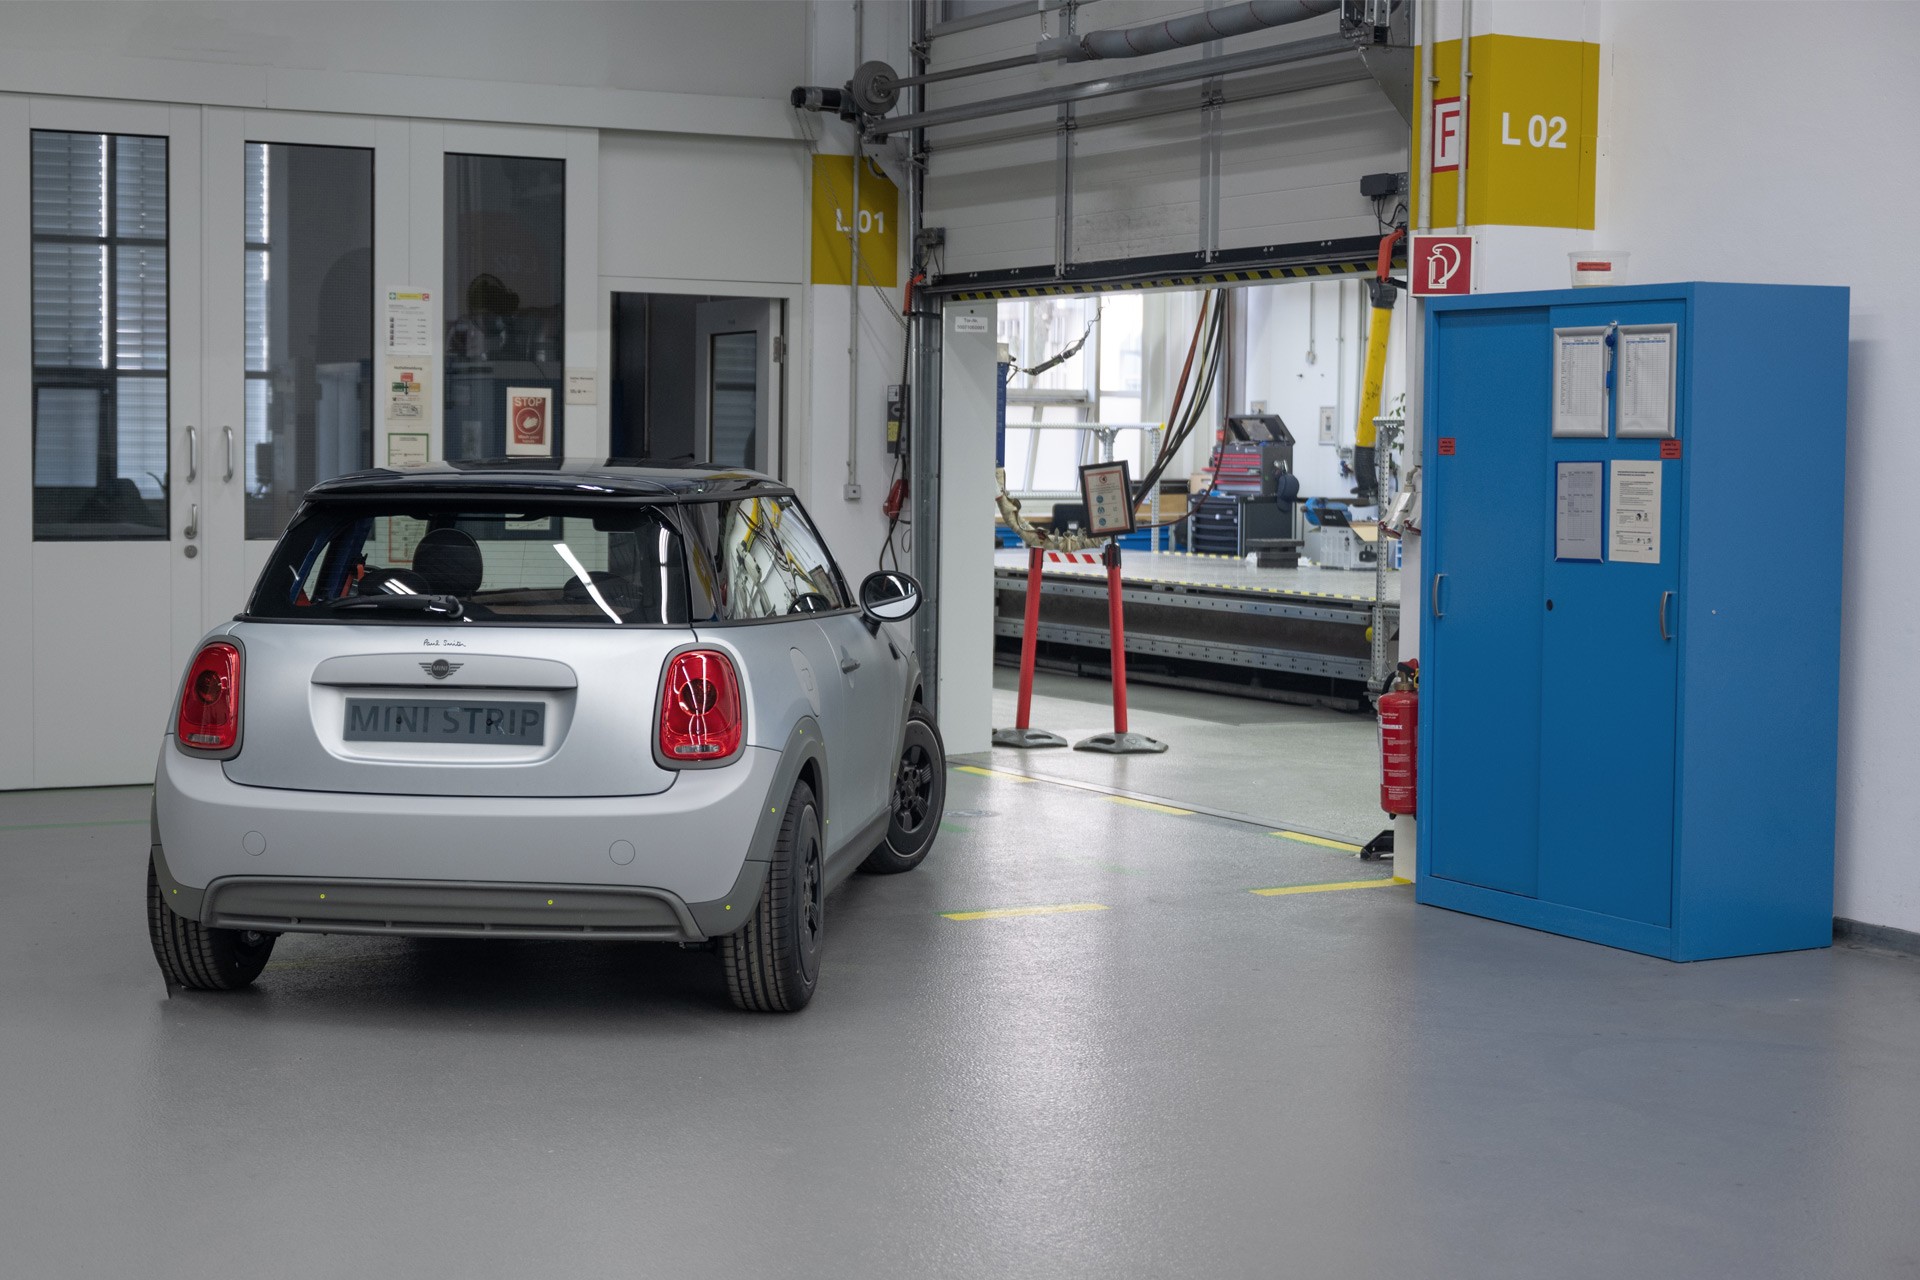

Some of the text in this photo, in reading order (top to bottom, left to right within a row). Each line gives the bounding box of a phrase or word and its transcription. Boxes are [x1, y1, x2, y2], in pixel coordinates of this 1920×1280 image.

[1441, 110, 1460, 157] F
[1502, 112, 1568, 149] L 02
[836, 208, 884, 234] L 01
[514, 397, 542, 407] STOP
[350, 705, 540, 737] MINI STRIP
